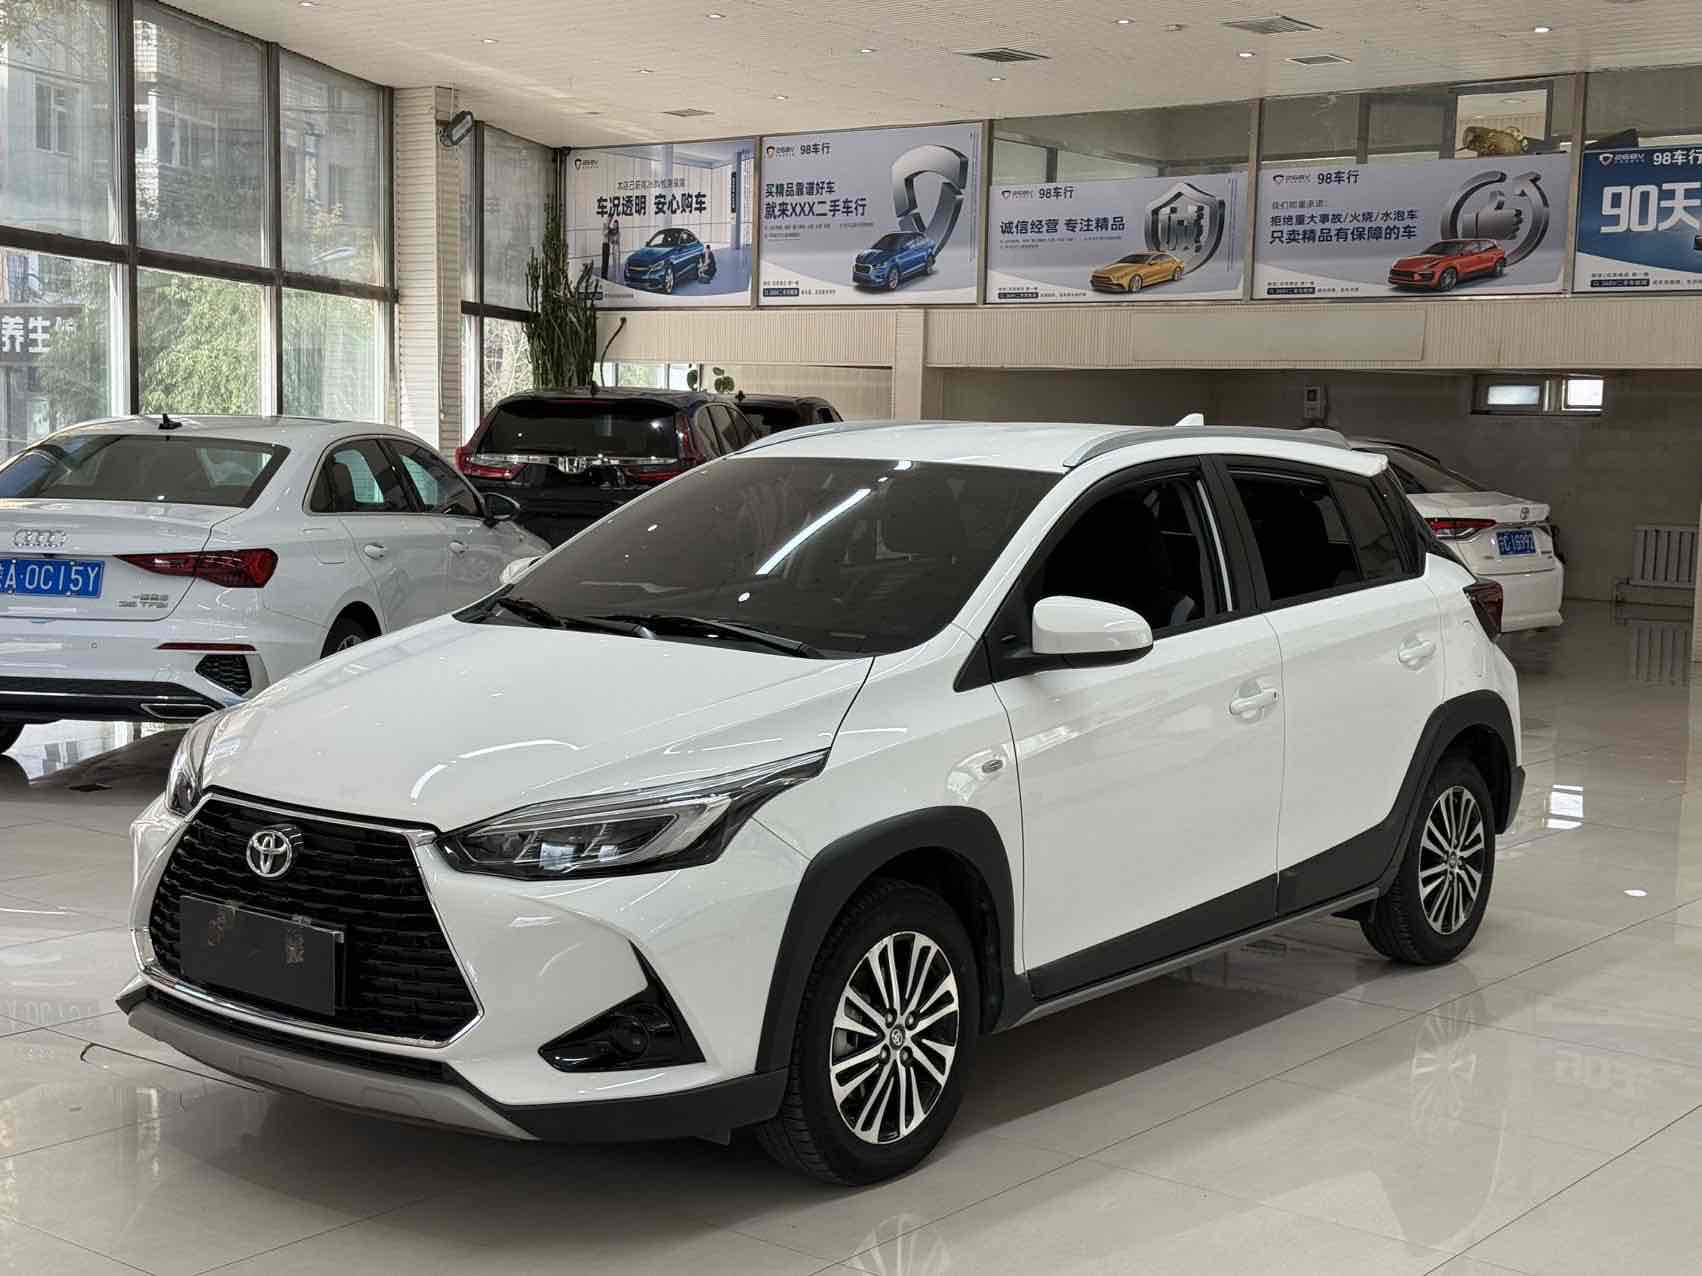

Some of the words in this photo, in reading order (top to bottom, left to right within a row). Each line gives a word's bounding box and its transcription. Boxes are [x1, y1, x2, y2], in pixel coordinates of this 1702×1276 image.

[800, 142, 831, 155] 98车行
[1653, 149, 1702, 166] 98车行
[1318, 170, 1360, 185] 98车行
[765, 181, 836, 199] 买精品靠谱好车
[1038, 185, 1075, 199] 98车行
[596, 195, 647, 218] 车况透明
[653, 191, 708, 216] 安心购车
[765, 197, 868, 220] 就来XXX二手车行
[1600, 181, 1702, 233] 90天
[1000, 218, 1060, 235] 诚信经营
[1063, 216, 1126, 233] 专注精品
[1269, 209, 1419, 227] 拒绝重大事故/火烧/水泡车
[1269, 225, 1418, 245] 只卖精品有保障的车
